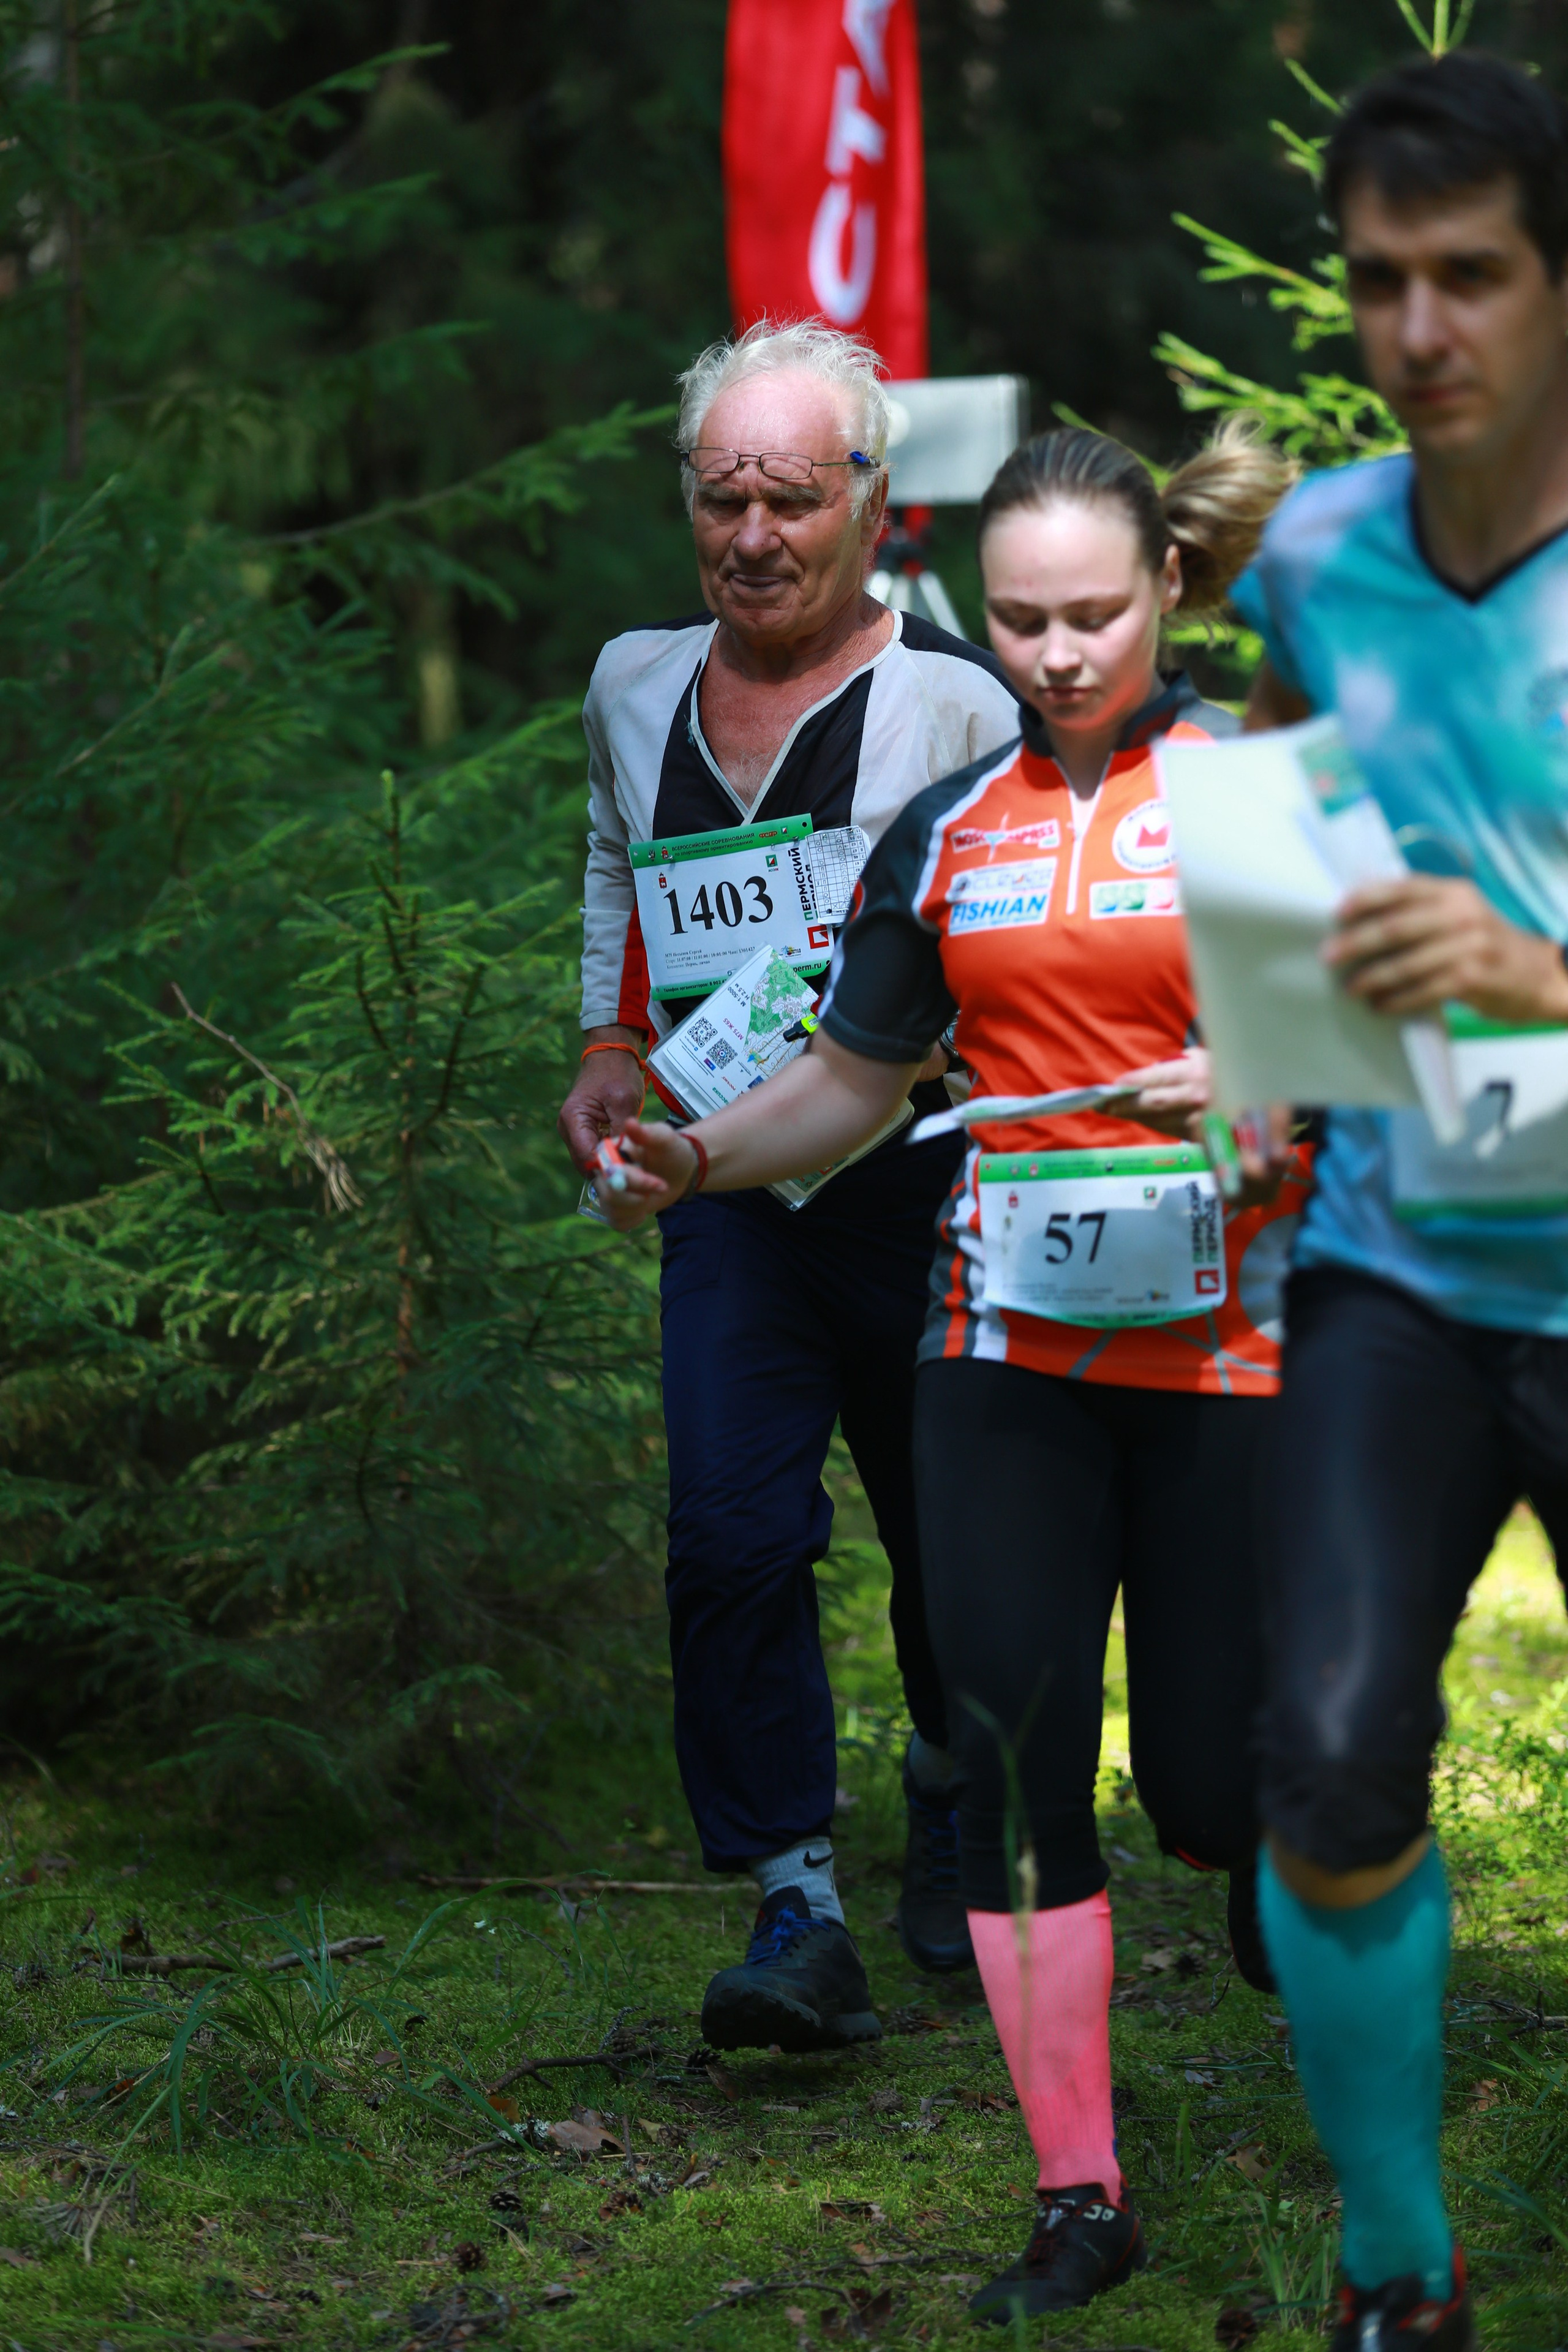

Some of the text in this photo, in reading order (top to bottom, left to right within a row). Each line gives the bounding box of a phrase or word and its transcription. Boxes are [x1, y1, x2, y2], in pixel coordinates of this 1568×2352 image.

[672, 832, 755, 851] ВСЕРОССИЙСКИЕ СОРЕВНОВАНИЯ
[710, 840, 753, 851] ориентированию
[788, 847, 813, 921] ПЕРМСКИЙ
[663, 876, 774, 935] 1403
[727, 987, 741, 1001] 1:5000
[737, 986, 747, 995] 2,5
[1044, 1211, 1107, 1265] 57
